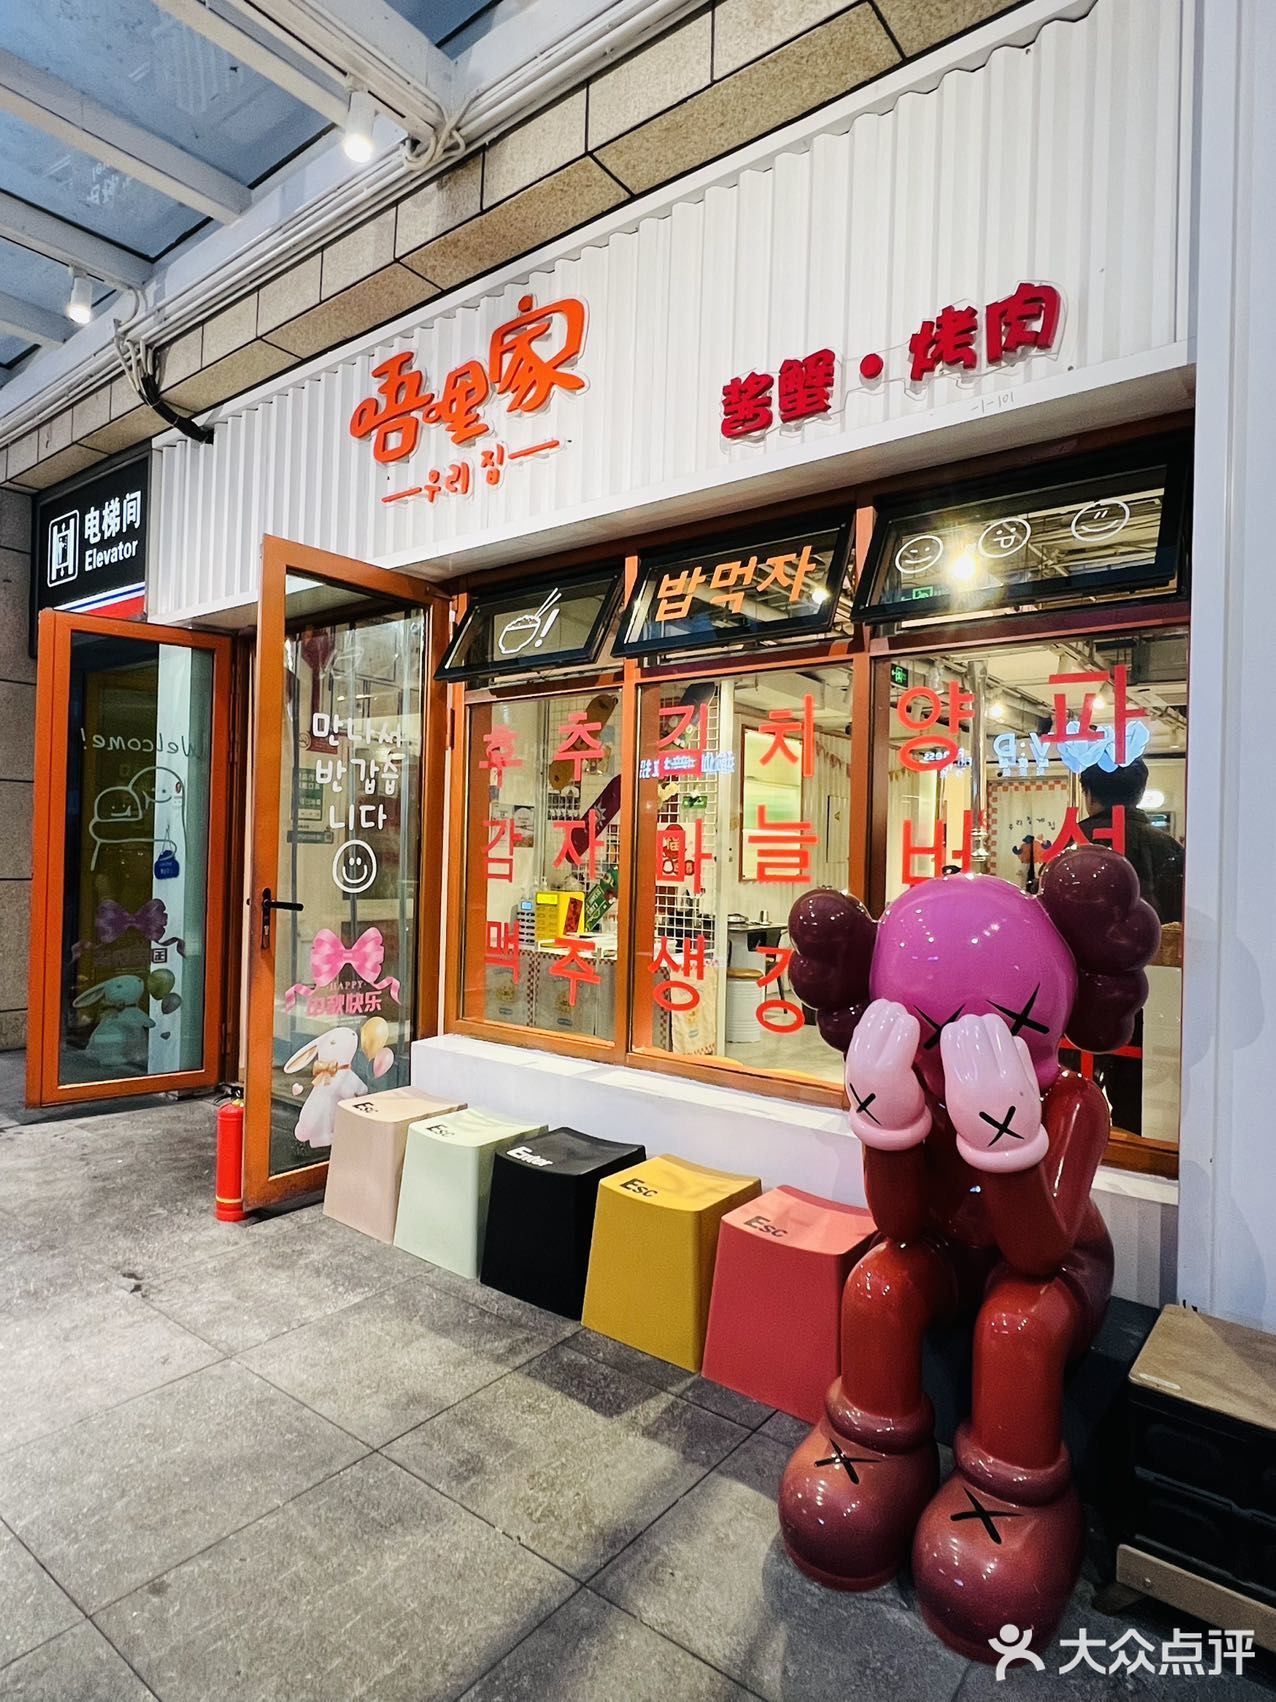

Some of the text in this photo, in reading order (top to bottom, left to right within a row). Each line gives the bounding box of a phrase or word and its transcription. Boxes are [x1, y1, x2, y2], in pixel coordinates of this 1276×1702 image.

[481, 443, 504, 485] 집
[84, 490, 142, 544] 电梯间
[84, 538, 139, 572] Elevator
[329, 804, 388, 830] 니다
[619, 1177, 658, 1197] Esc
[744, 1215, 788, 1237] Esc
